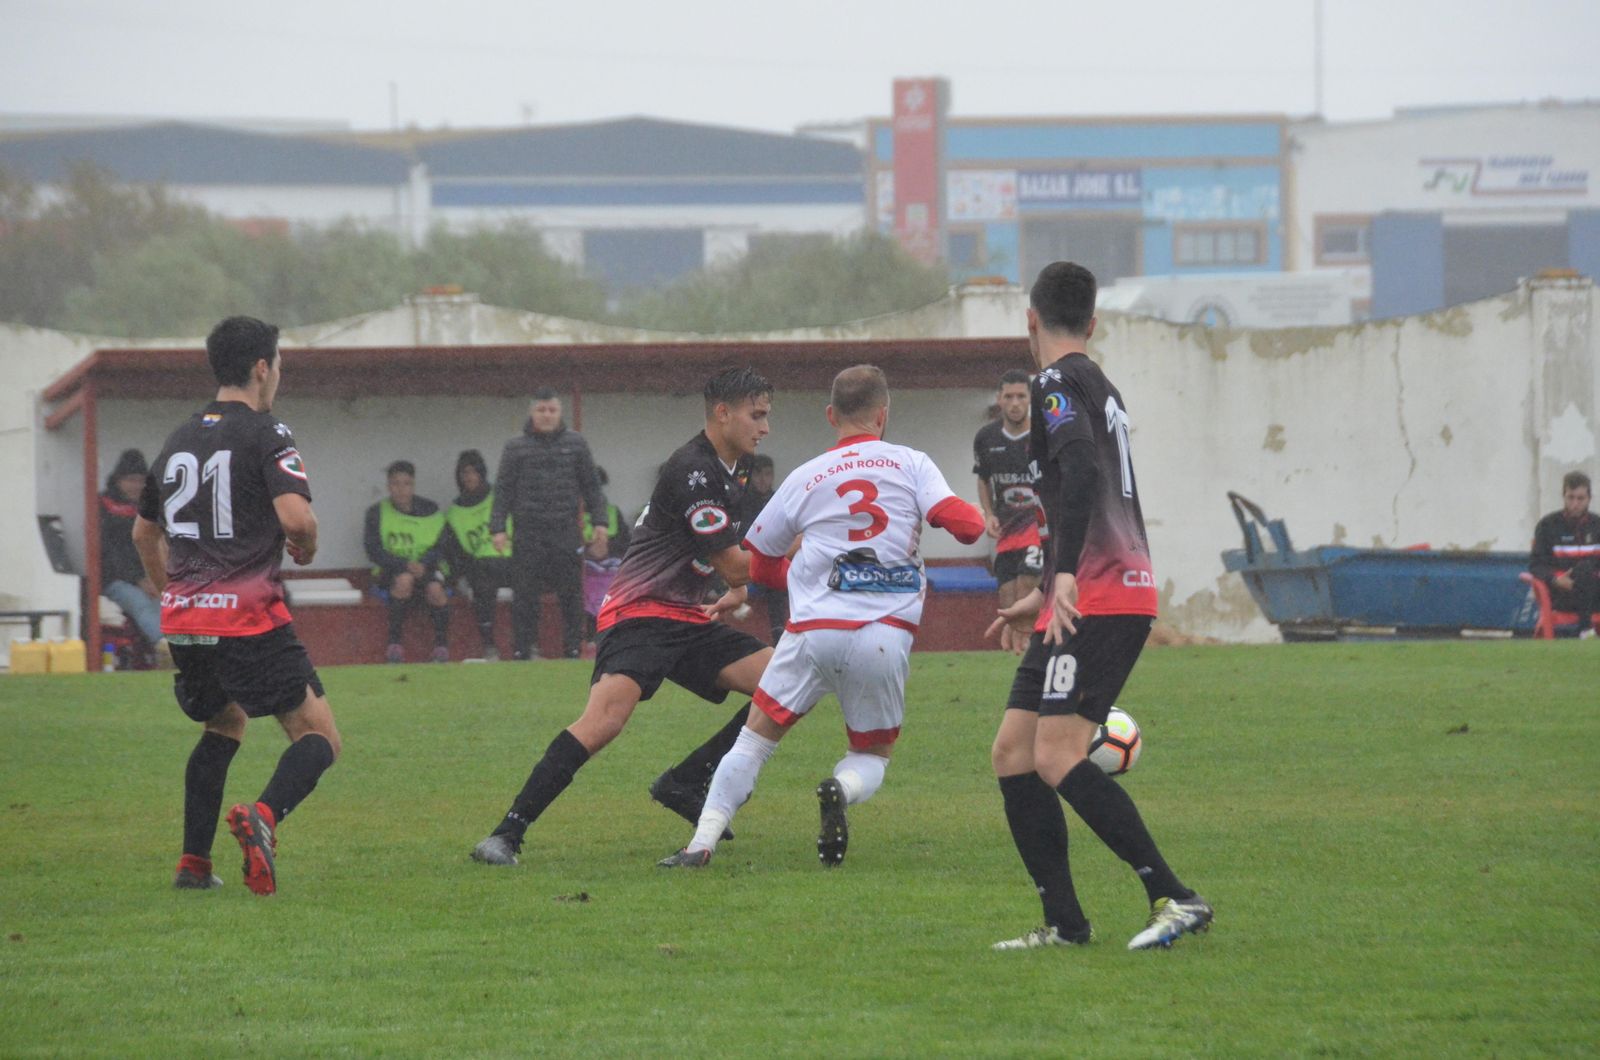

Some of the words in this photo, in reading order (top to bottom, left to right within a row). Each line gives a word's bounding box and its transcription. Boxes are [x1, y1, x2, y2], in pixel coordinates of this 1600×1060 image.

[1019, 173, 1069, 197] BAZAR
[806, 474, 827, 491] C.D.
[827, 461, 853, 476] SAN
[857, 459, 900, 470] ROQUE
[163, 450, 234, 540] 21
[835, 479, 889, 541] 3
[845, 568, 914, 582] GÓMEZ
[1043, 654, 1077, 692] 18
